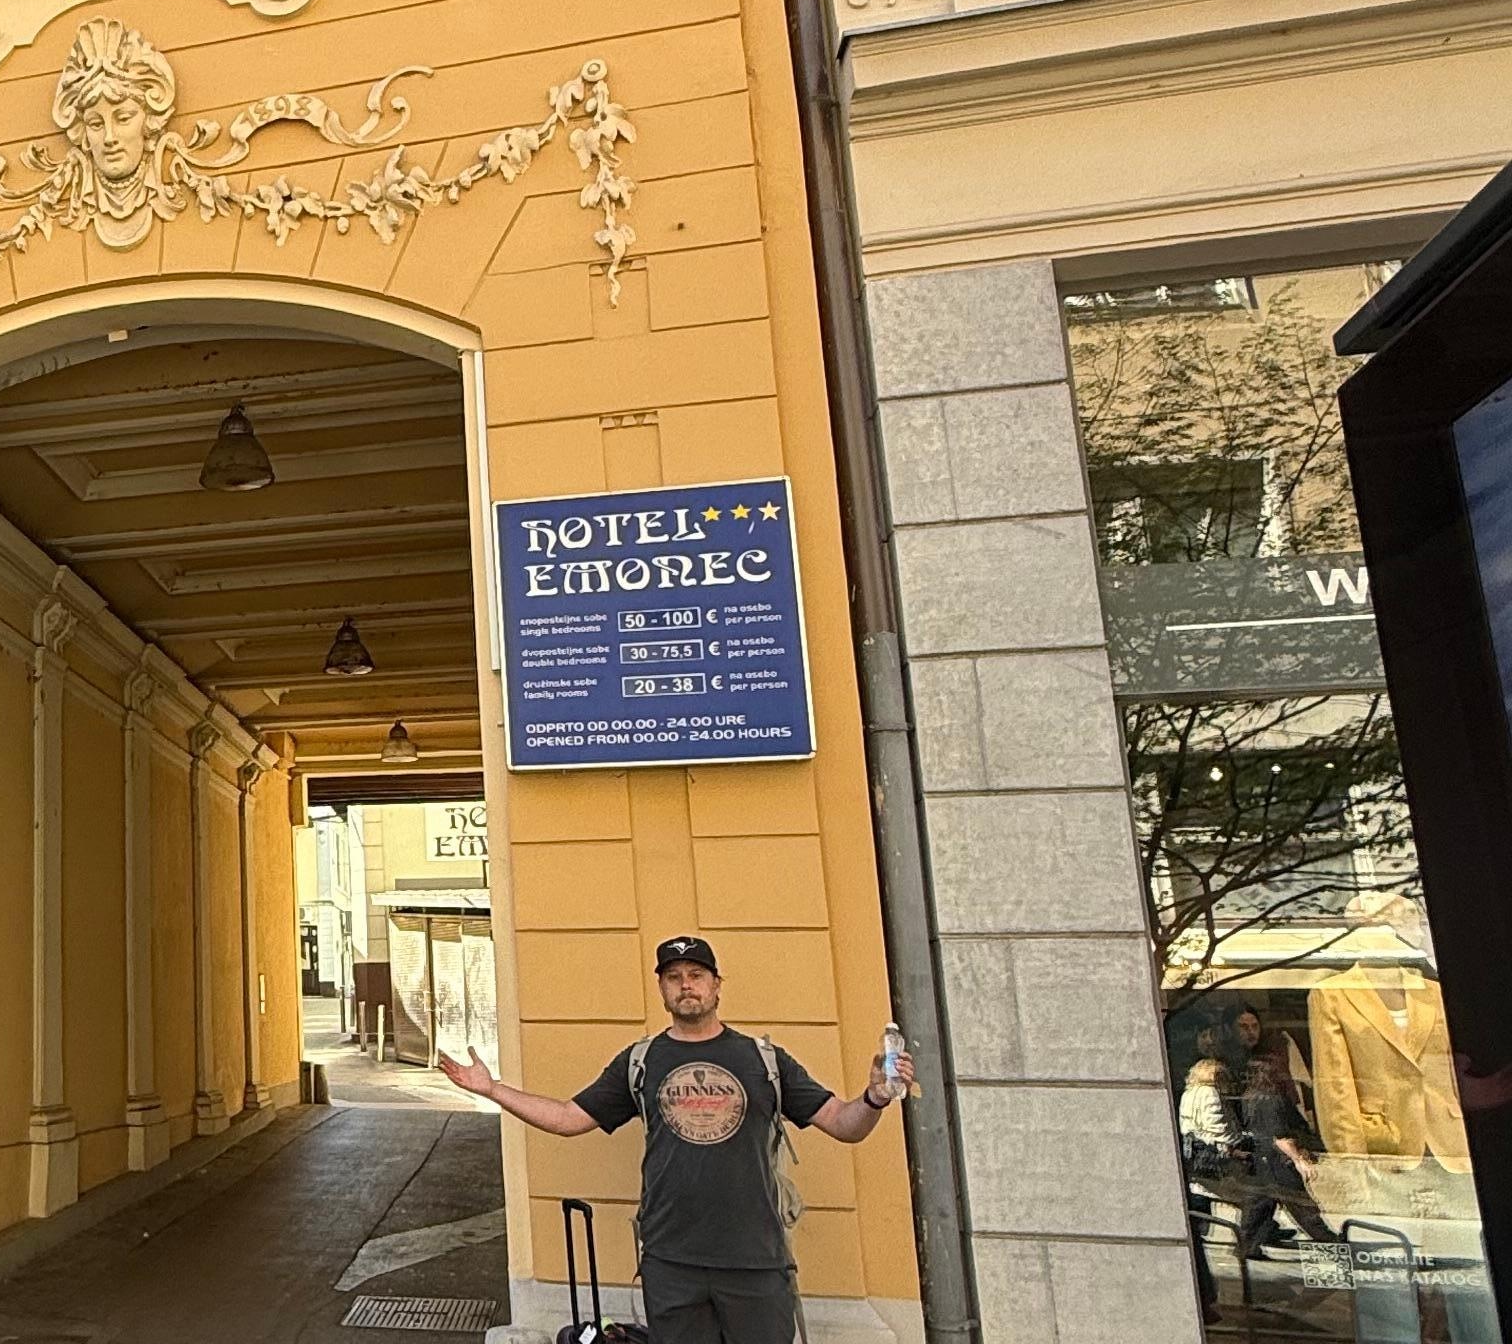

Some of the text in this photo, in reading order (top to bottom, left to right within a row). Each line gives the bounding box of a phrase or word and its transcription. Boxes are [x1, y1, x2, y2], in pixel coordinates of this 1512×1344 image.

[521, 509, 706, 558] HOTEL
[523, 550, 772, 597] EMONEC
[739, 603, 772, 612] osebo
[583, 613, 607, 622] sobe
[625, 613, 645, 628] 50
[662, 611, 694, 626] 100
[706, 608, 718, 624] €
[725, 614, 782, 626] per person
[520, 625, 601, 637] single bedrooms
[742, 636, 775, 645] osebo
[585, 645, 610, 654] sobe
[630, 647, 648, 659] 30
[661, 645, 693, 658] 75,5
[709, 641, 721, 656] €
[728, 648, 785, 659] per person
[522, 657, 607, 668] double bedrooms
[729, 669, 777, 680] na osebo
[573, 677, 597, 686] sobe
[634, 679, 656, 694] 20
[672, 677, 694, 692] 38
[711, 675, 723, 690] €
[730, 681, 788, 692] per person
[523, 690, 588, 699] family rooms
[526, 722, 584, 734] ODPRTO
[587, 720, 608, 731] OD
[611, 719, 657, 730] 00.00
[715, 715, 746, 726] URE
[526, 735, 584, 747] OPENED
[587, 734, 629, 745] FROM
[632, 732, 679, 743] 00.00
[689, 730, 735, 741] 24.00
[739, 727, 792, 739] HOURS
[666, 1084, 735, 1097] GUINNESS
[1399, 1268, 1481, 1287] KATALOG
